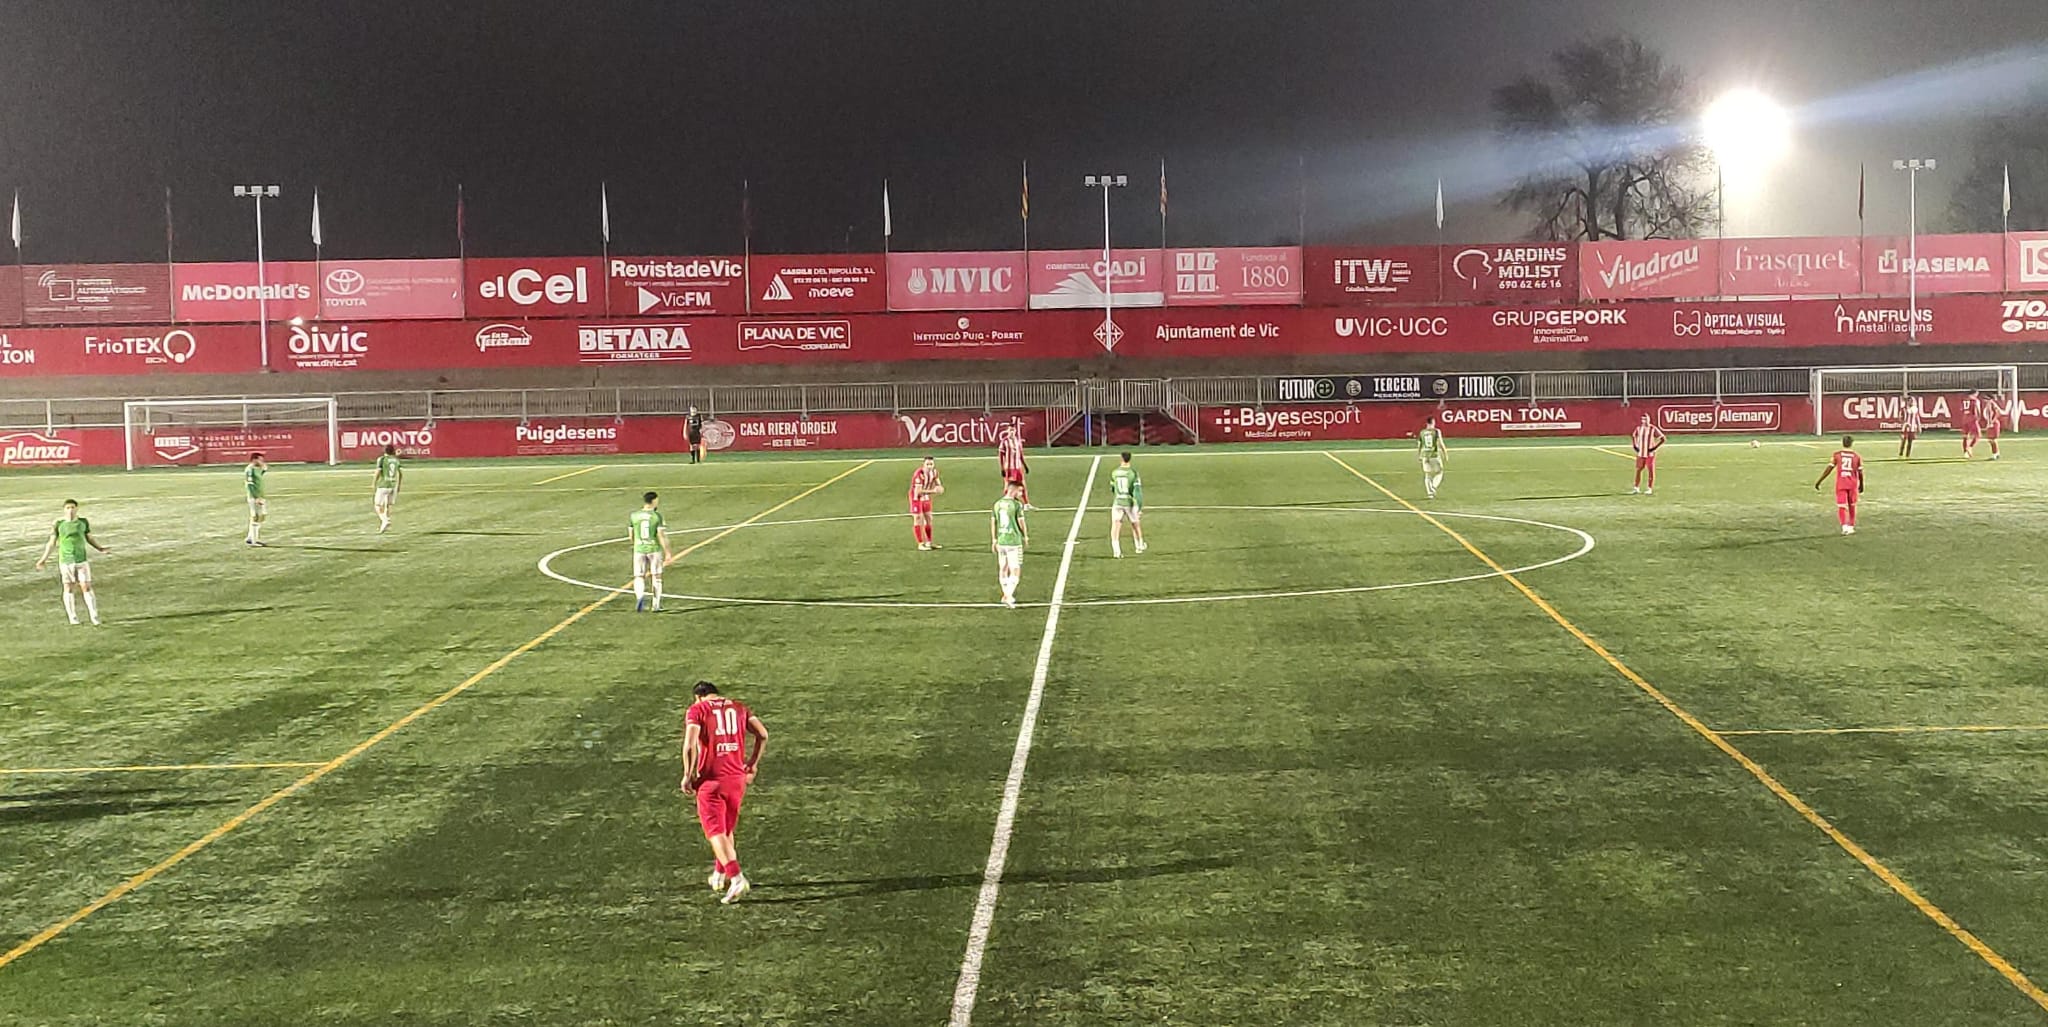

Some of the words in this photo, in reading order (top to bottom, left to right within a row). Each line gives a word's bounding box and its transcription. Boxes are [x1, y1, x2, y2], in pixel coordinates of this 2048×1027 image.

[1493, 248, 1567, 262] JARDINS
[611, 260, 742, 278] RevistadeVic
[1093, 256, 1146, 277] CADÍ
[1599, 245, 1699, 289] Viladrau
[1902, 256, 1990, 273] PASEMA
[930, 267, 1012, 293] MVIC
[1242, 265, 1289, 288] 1880
[1499, 280, 1518, 289] 690
[1520, 280, 1533, 288] 62
[1550, 279, 1562, 288] 16
[182, 284, 311, 301] McDonald's
[661, 291, 711, 307] VicFM
[809, 287, 855, 299] moeve
[325, 298, 367, 306] TOYOTA
[1746, 313, 1786, 327] VISUAL
[1856, 309, 1932, 322] ANFRUNS
[579, 327, 691, 350] BETARA
[744, 327, 794, 340] PLANA
[797, 327, 816, 340] DE
[819, 326, 844, 339] VIC
[1156, 323, 1237, 342] Ajuntament
[1239, 322, 1256, 338] de
[1259, 322, 1280, 338] Vic
[85, 336, 162, 354] FrioTEX
[1374, 377, 1420, 392] TERCERA
[1441, 408, 1512, 423] GARDEN
[1518, 407, 1567, 421] TONA
[1665, 410, 1713, 425] Viatges
[1719, 409, 1774, 425] Alemany
[516, 425, 617, 443] Puigdesens
[740, 422, 766, 436] CASA
[768, 421, 798, 436] RIERA
[800, 420, 837, 435] ORDEIX
[3, 441, 70, 464] planxa
[712, 708, 738, 736] 10
